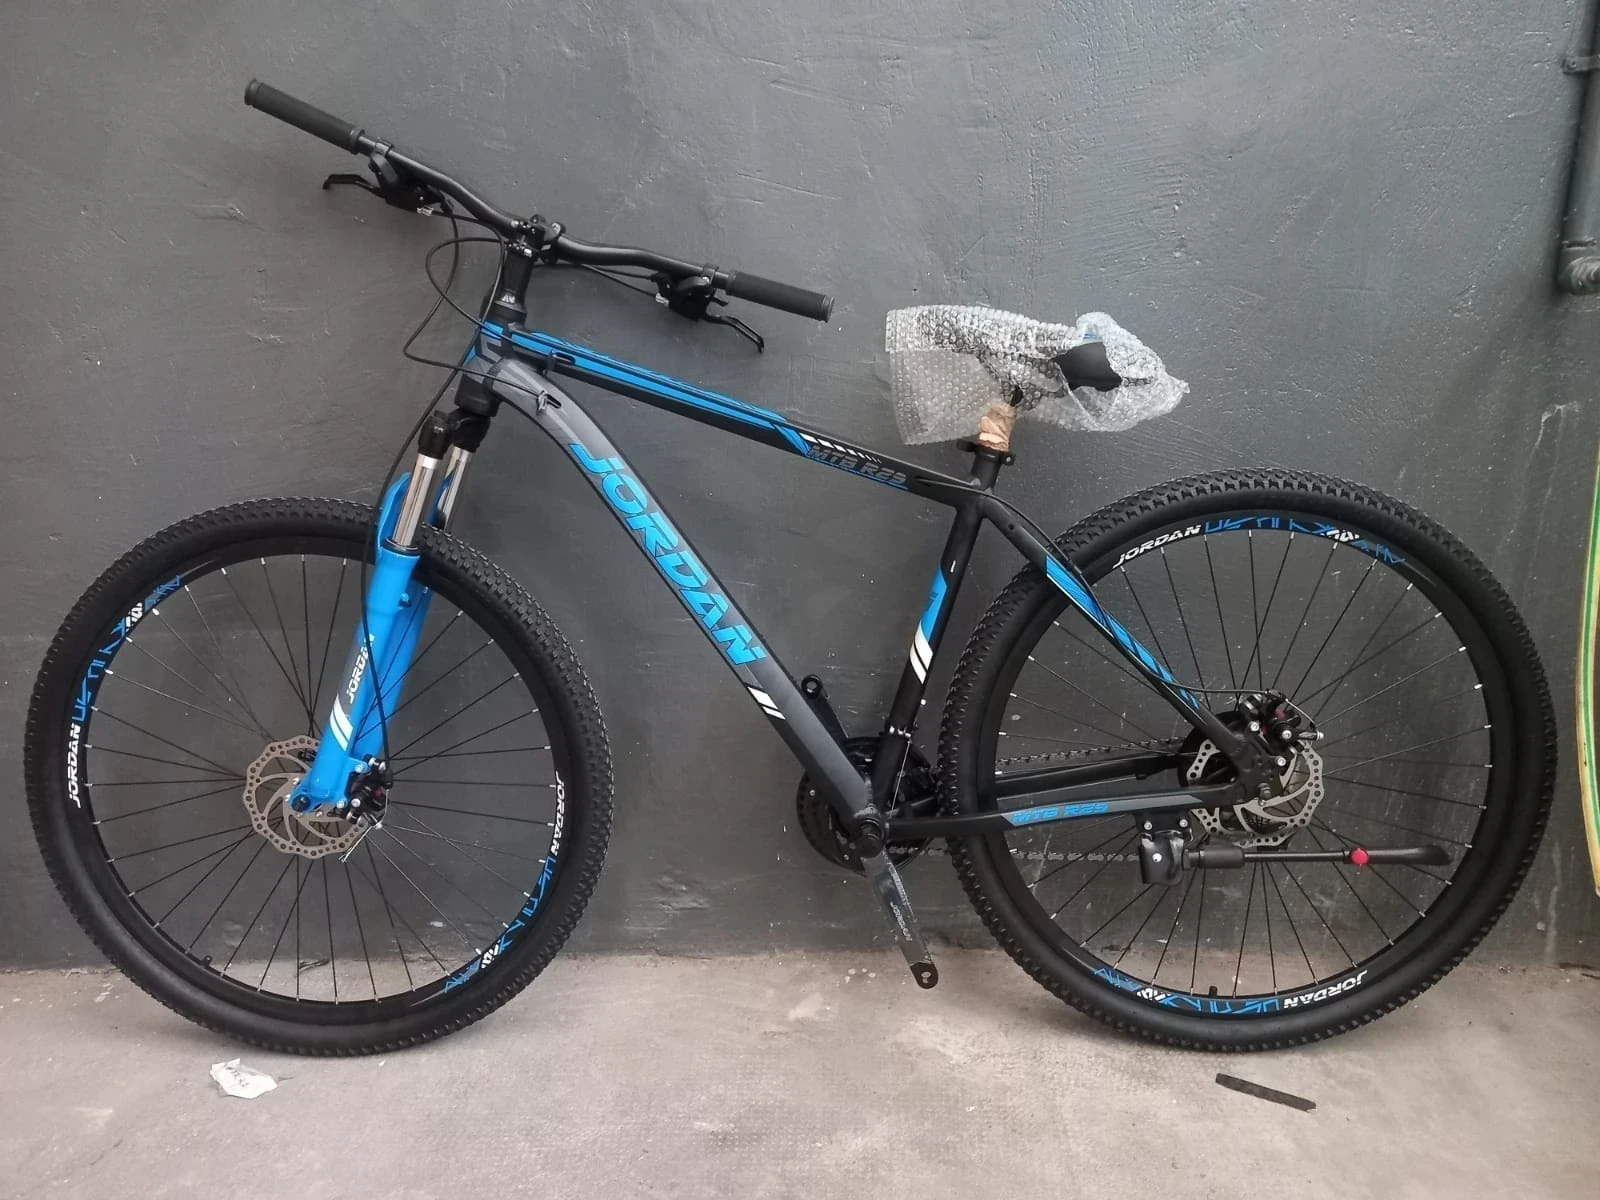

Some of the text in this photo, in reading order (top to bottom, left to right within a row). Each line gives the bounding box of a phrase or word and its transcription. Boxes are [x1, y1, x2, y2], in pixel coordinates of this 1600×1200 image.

[807, 445, 858, 469] MTB
[568, 443, 767, 665] JORDAN
[1112, 525, 1201, 569] JORDAN
[67, 722, 81, 808] JORDAN
[549, 771, 565, 856] JORDAN
[1283, 969, 1368, 1009] JORDAN
